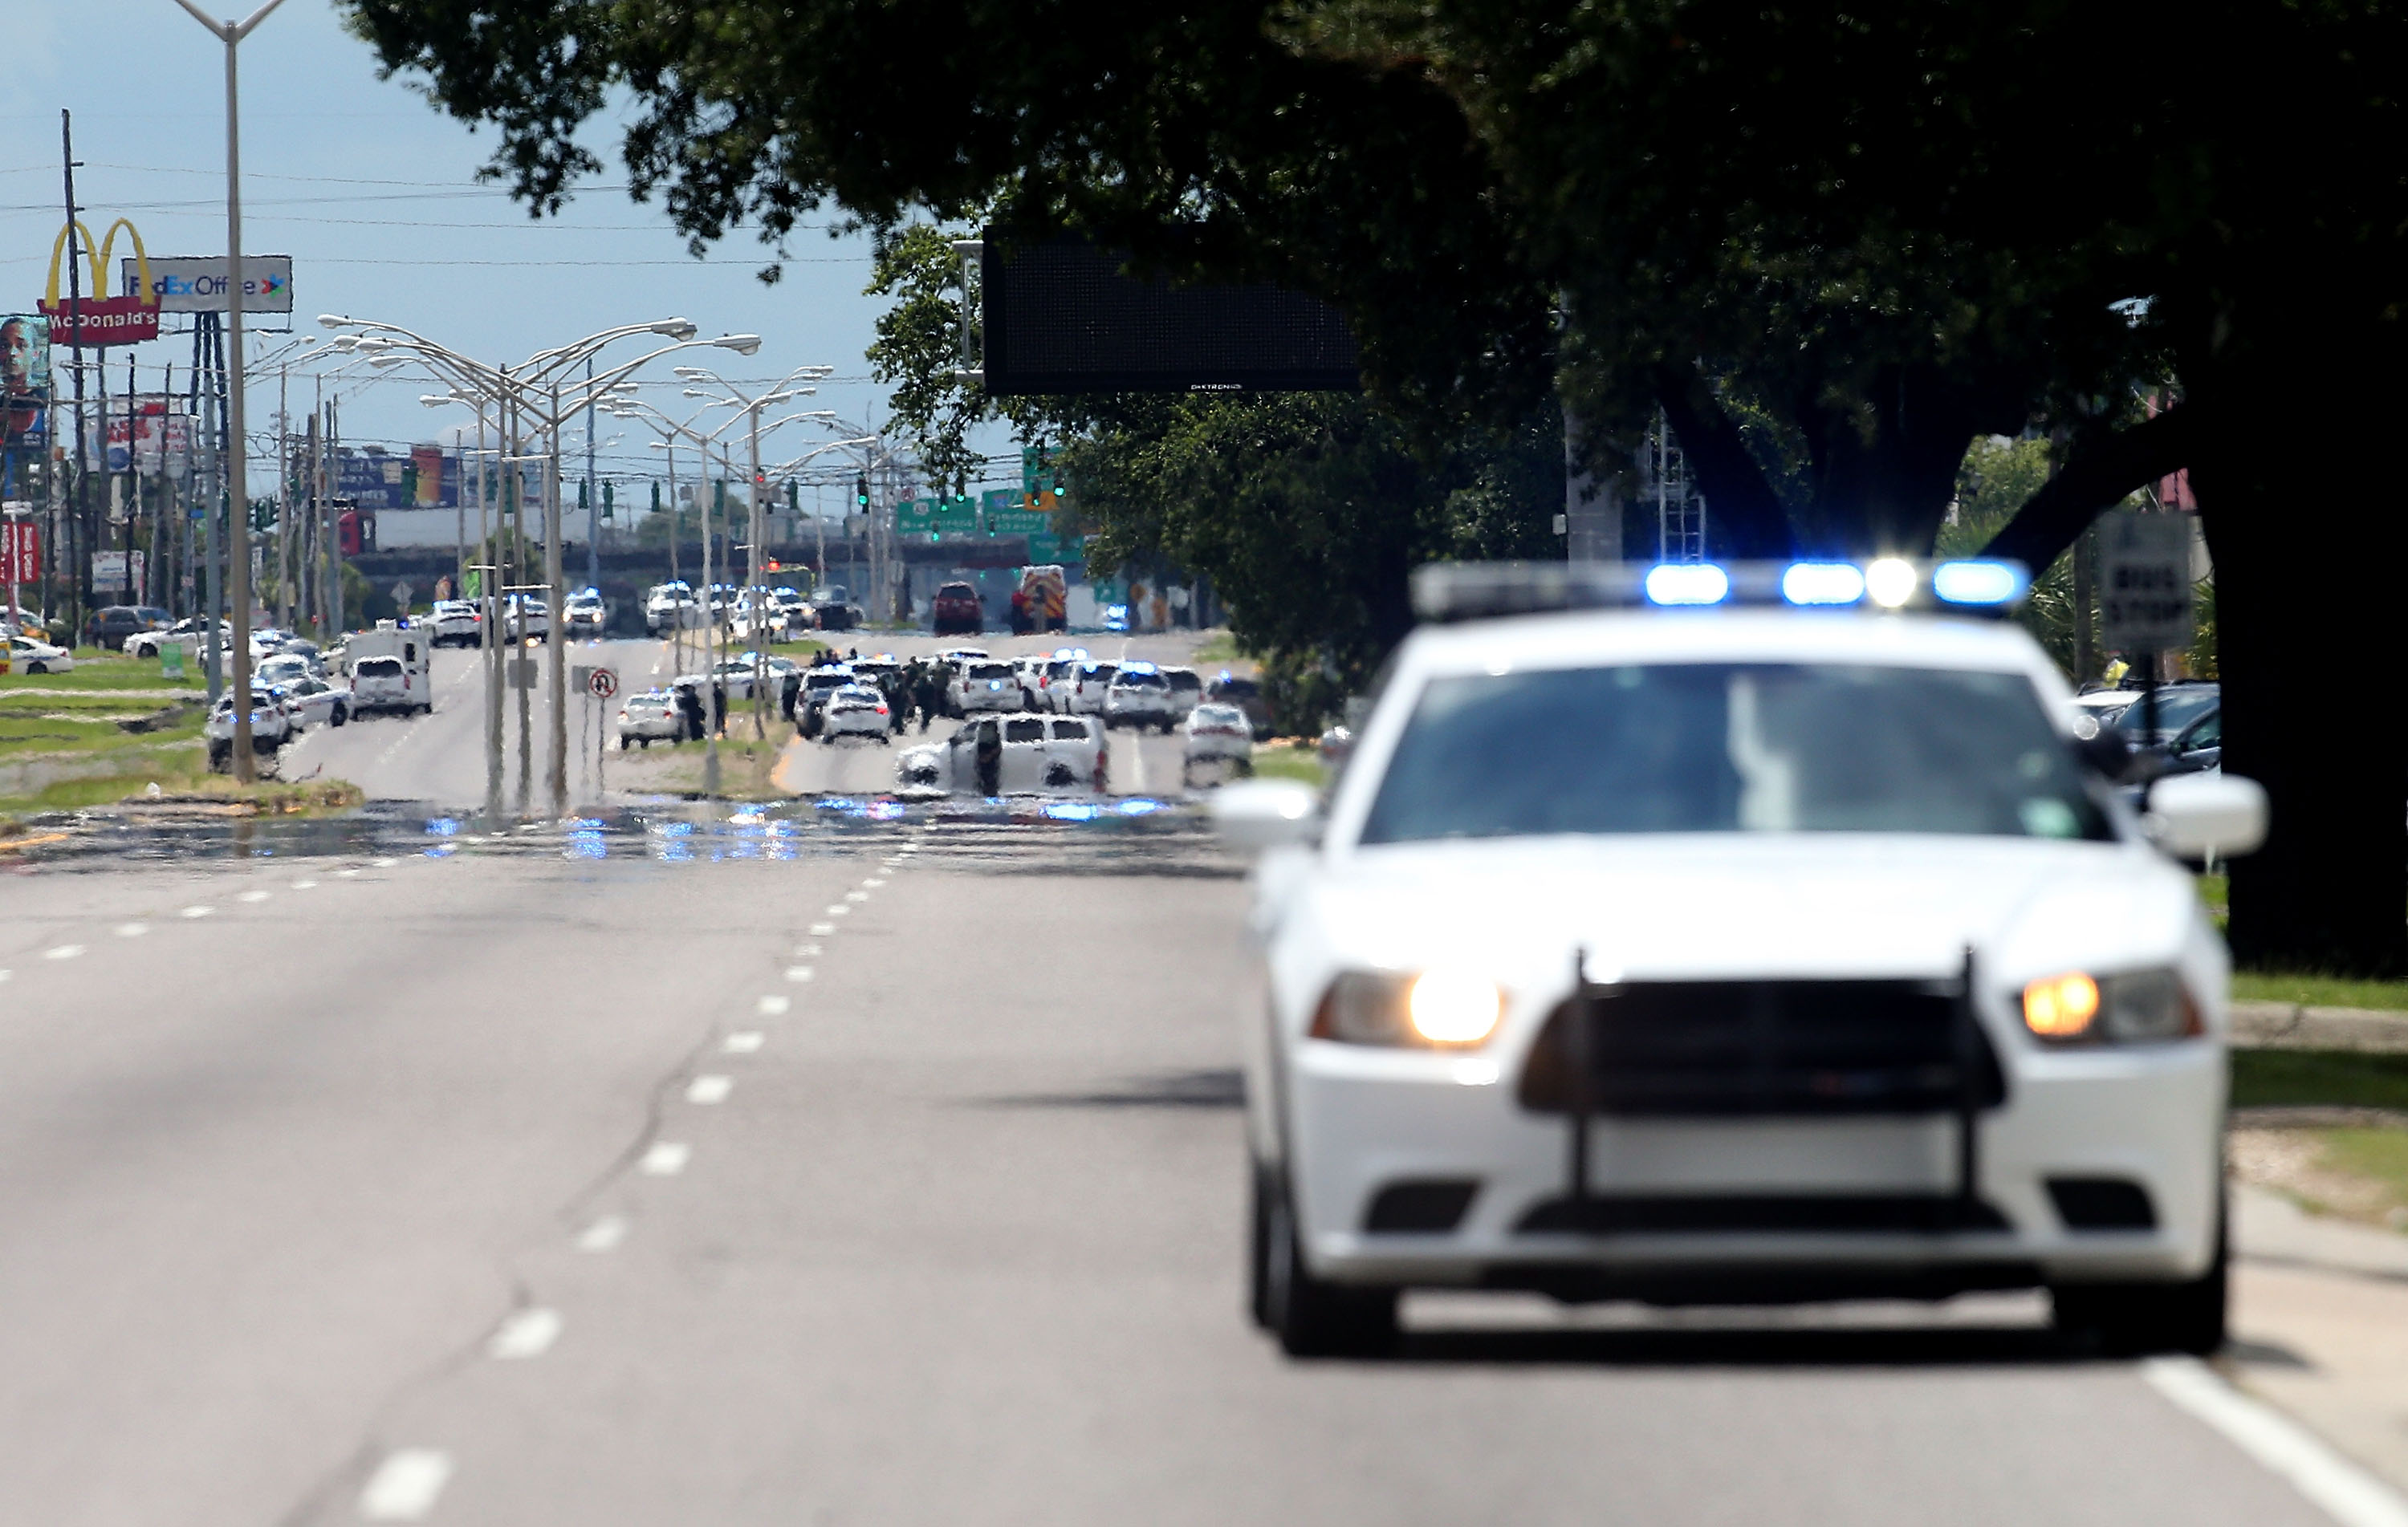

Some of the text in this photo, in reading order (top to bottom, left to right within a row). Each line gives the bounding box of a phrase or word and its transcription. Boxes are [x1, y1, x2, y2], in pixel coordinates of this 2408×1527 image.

[129, 275, 256, 295] FdEx Offe
[49, 312, 157, 328] McDonald's
